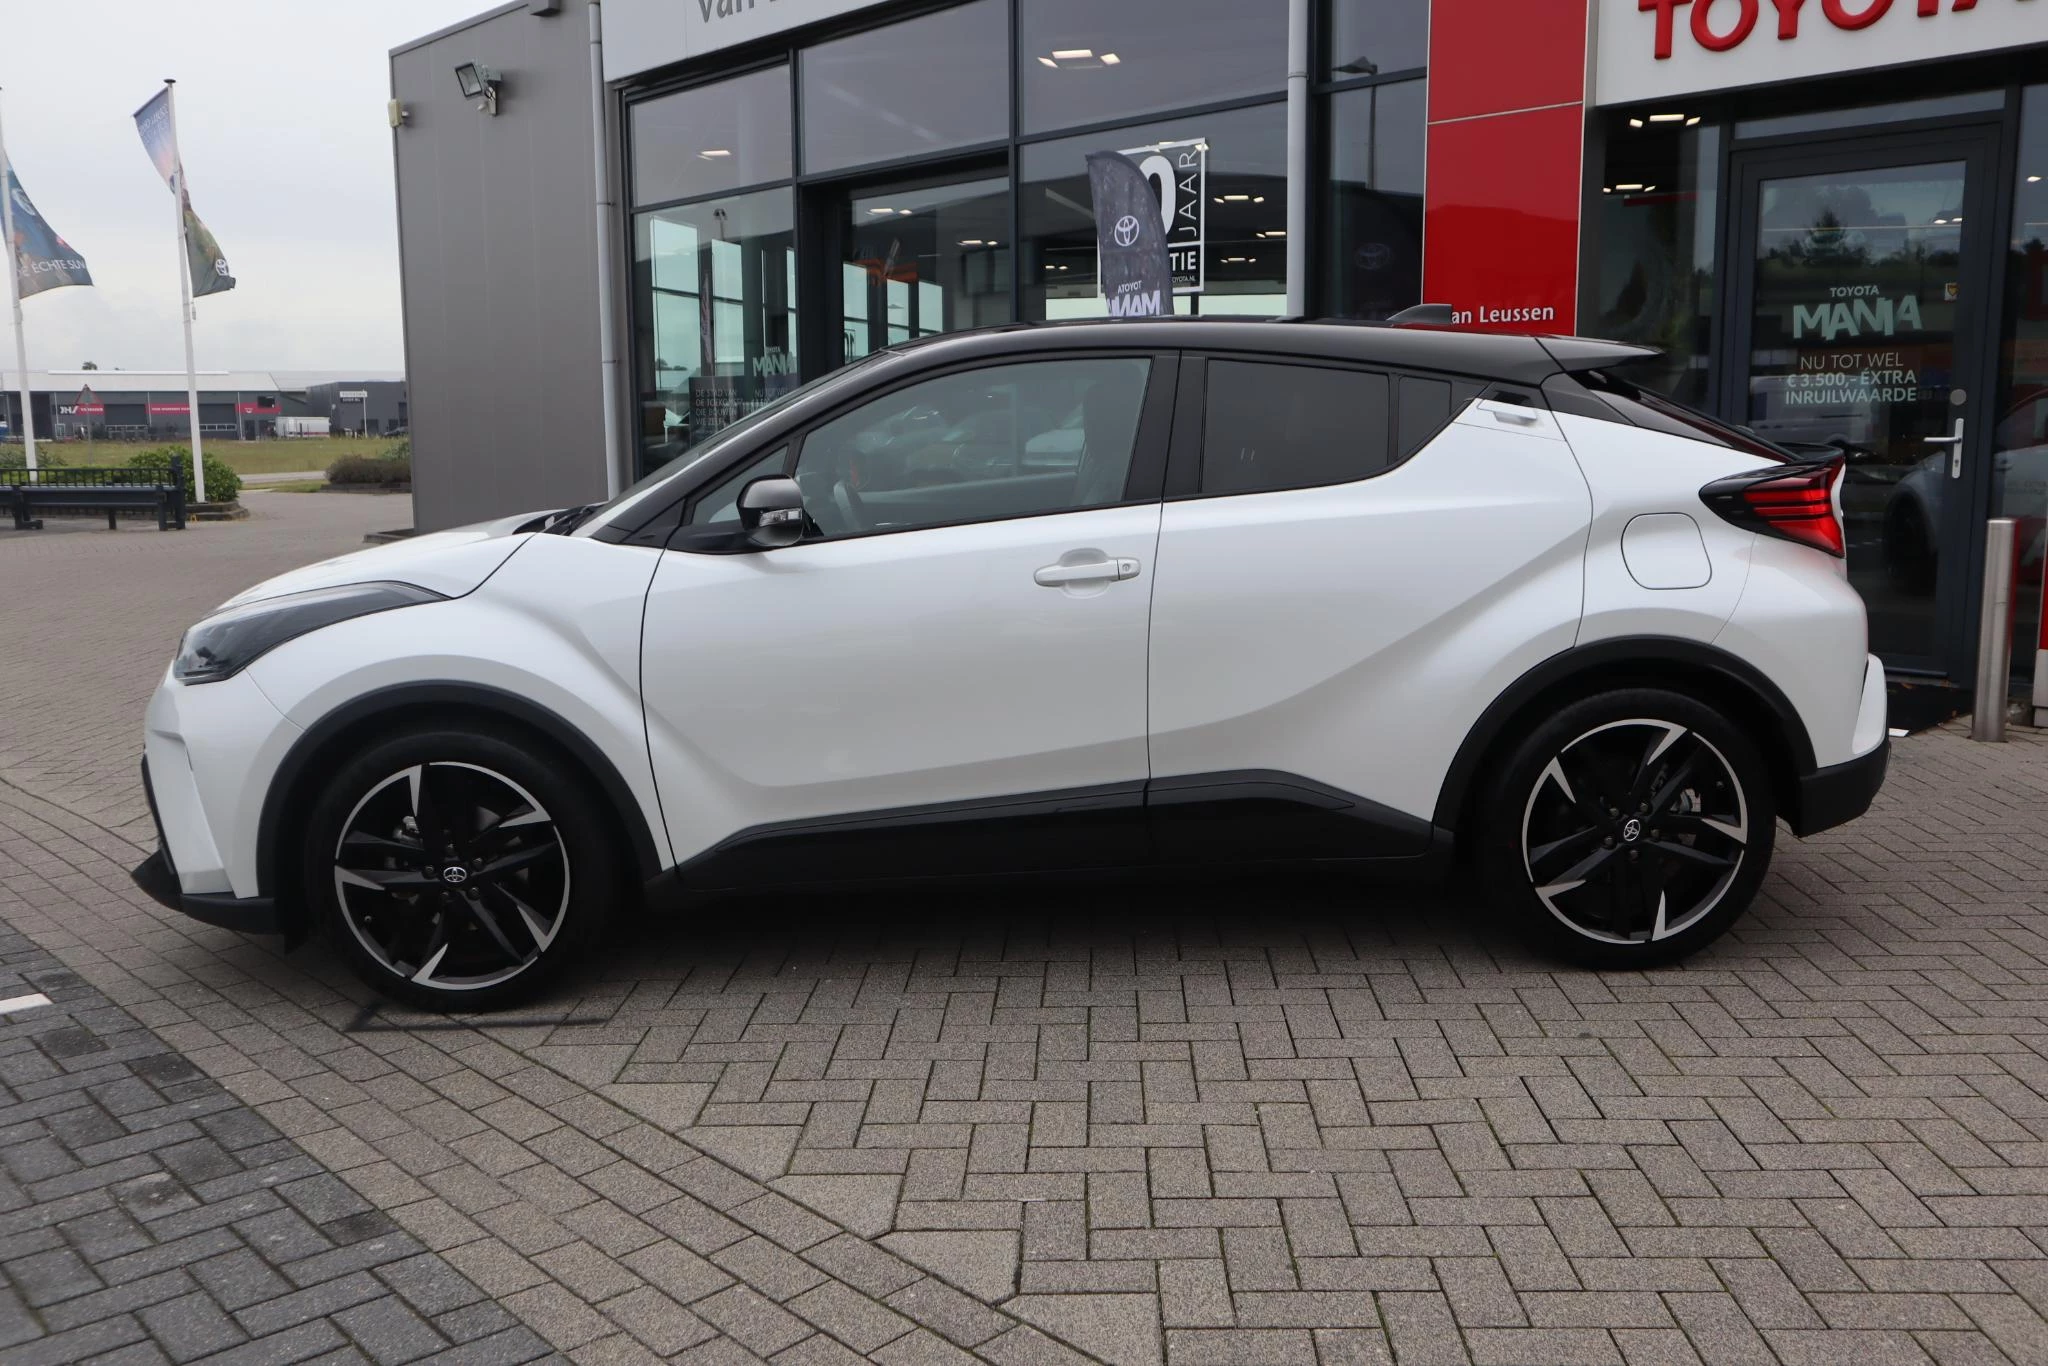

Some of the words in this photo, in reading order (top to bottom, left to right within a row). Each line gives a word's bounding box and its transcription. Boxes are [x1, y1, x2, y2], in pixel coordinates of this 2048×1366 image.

[1178, 150, 1198, 238] JAAR
[32, 259, 68, 273] ECHTE
[1829, 285, 1880, 298] TOYOTA
[1479, 305, 1554, 323] Leussen
[1792, 294, 1923, 341] MANIA
[752, 352, 797, 377] MANIA
[1800, 355, 1825, 370] NU
[1831, 353, 1862, 369] TOT
[1867, 352, 1904, 367] WEL
[1787, 373, 1797, 388] €
[1785, 387, 1917, 405] INRUILWAARDE
